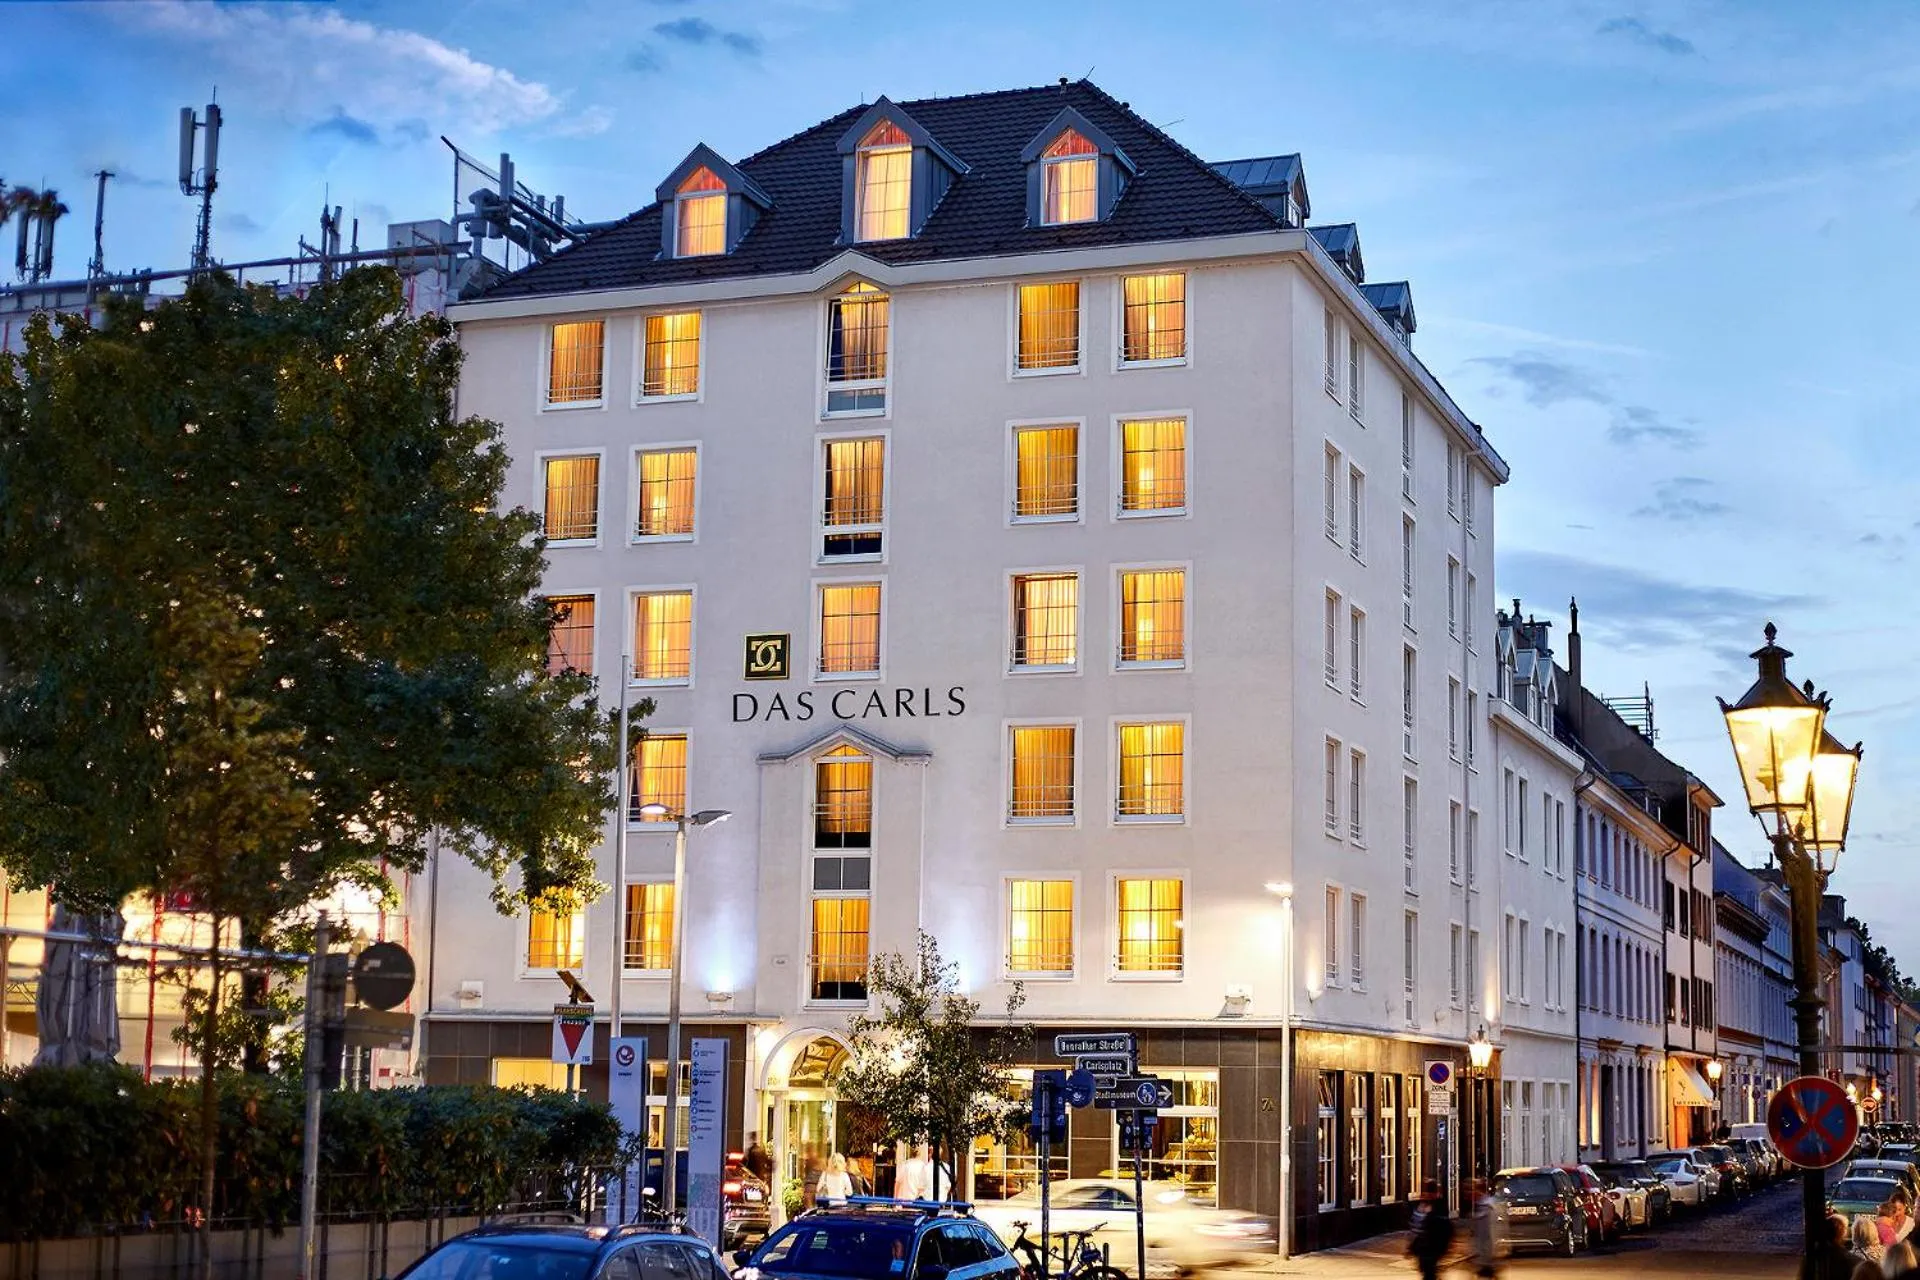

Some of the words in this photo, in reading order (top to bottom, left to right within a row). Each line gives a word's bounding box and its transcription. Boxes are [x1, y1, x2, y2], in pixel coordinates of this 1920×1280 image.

[733, 691, 815, 722] DAS
[831, 686, 966, 720] CARLS
[1099, 1040, 1125, 1051] Straße
[1086, 1060, 1122, 1072] Carlsplatz
